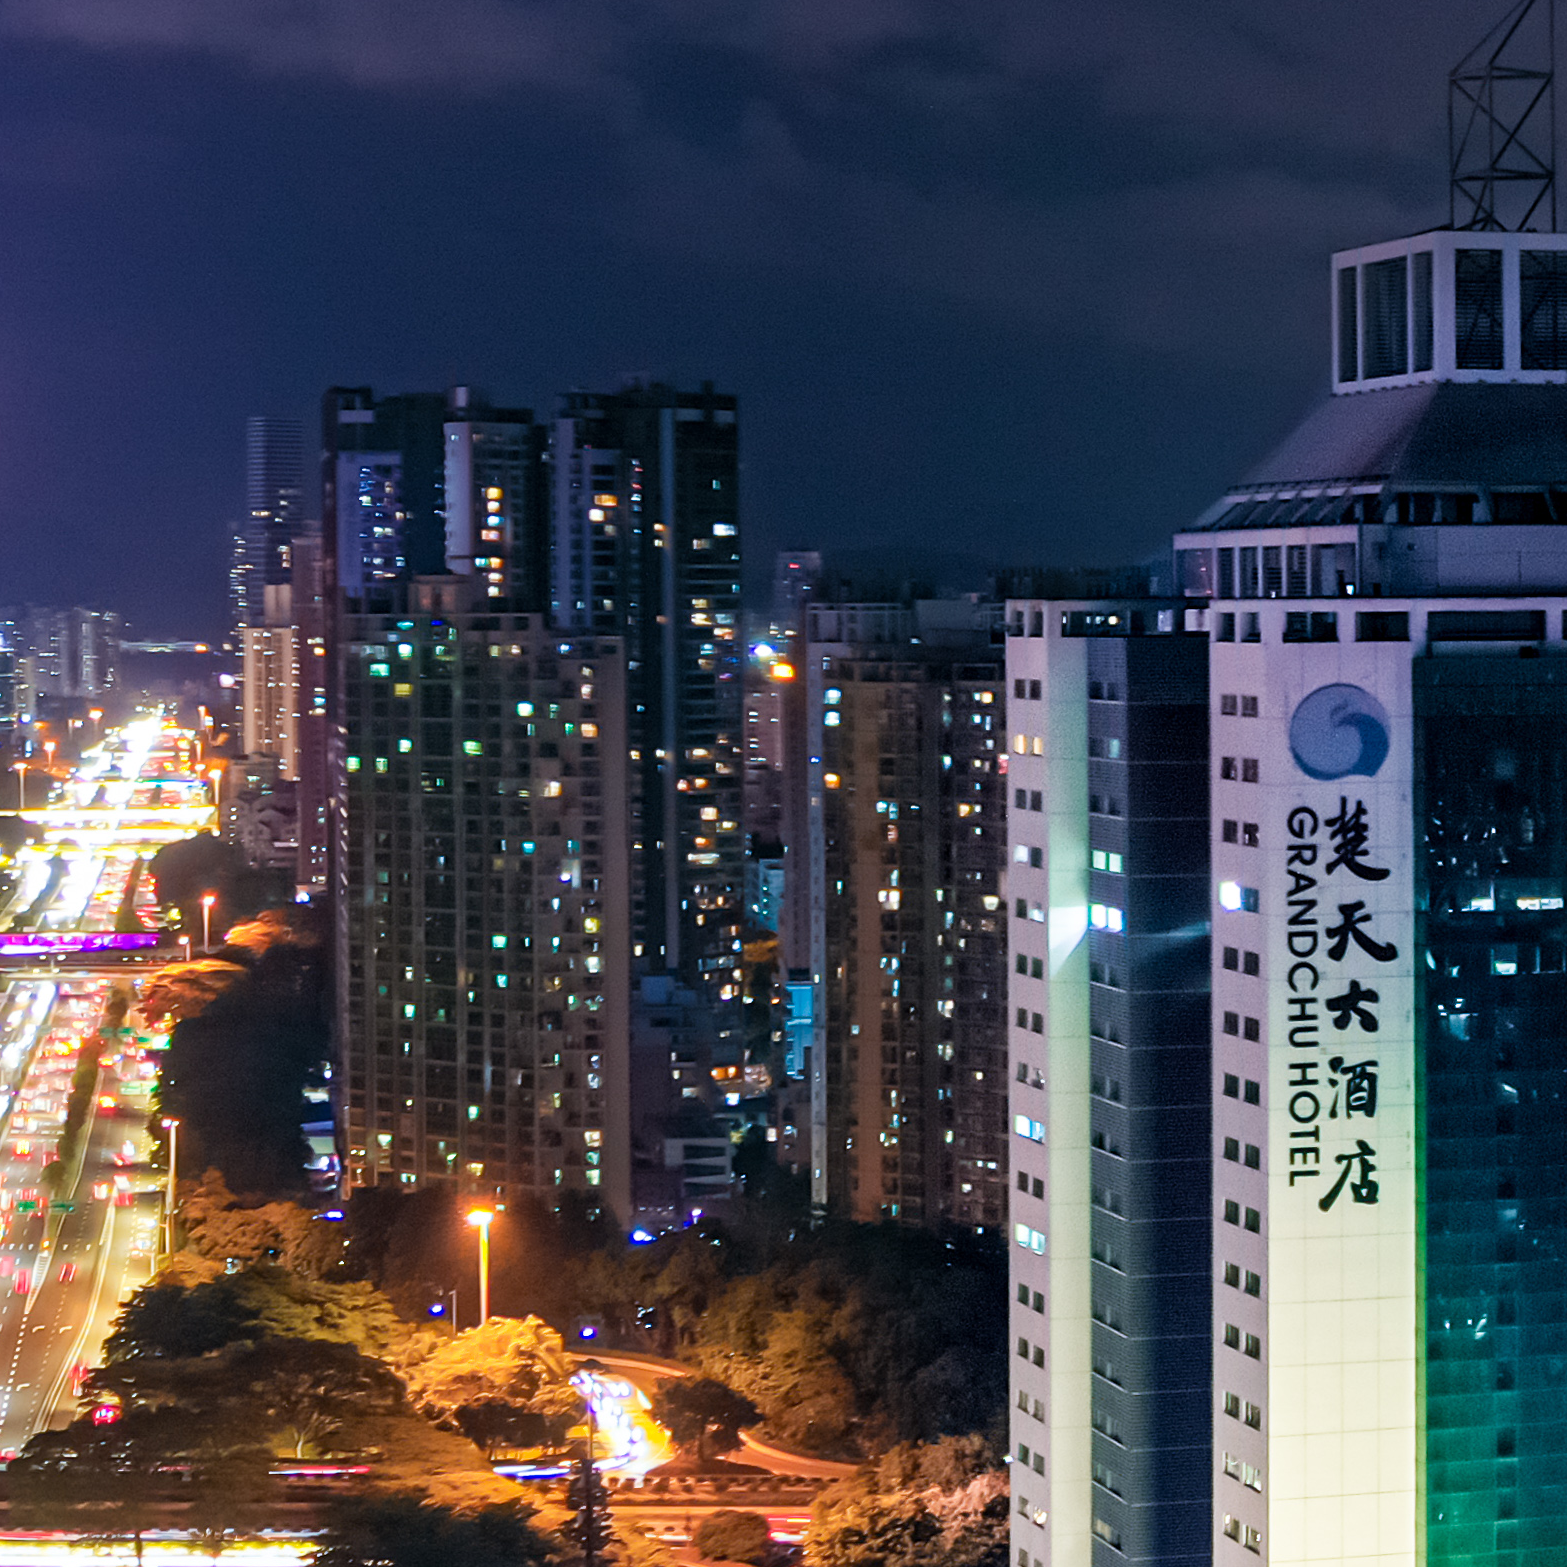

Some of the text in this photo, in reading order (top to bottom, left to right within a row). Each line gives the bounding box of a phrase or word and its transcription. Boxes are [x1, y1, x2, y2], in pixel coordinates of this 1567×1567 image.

[1286, 806, 1321, 1187] GRANDCHU HOTEL
[1318, 796, 1399, 1212] 楚天大酒店
